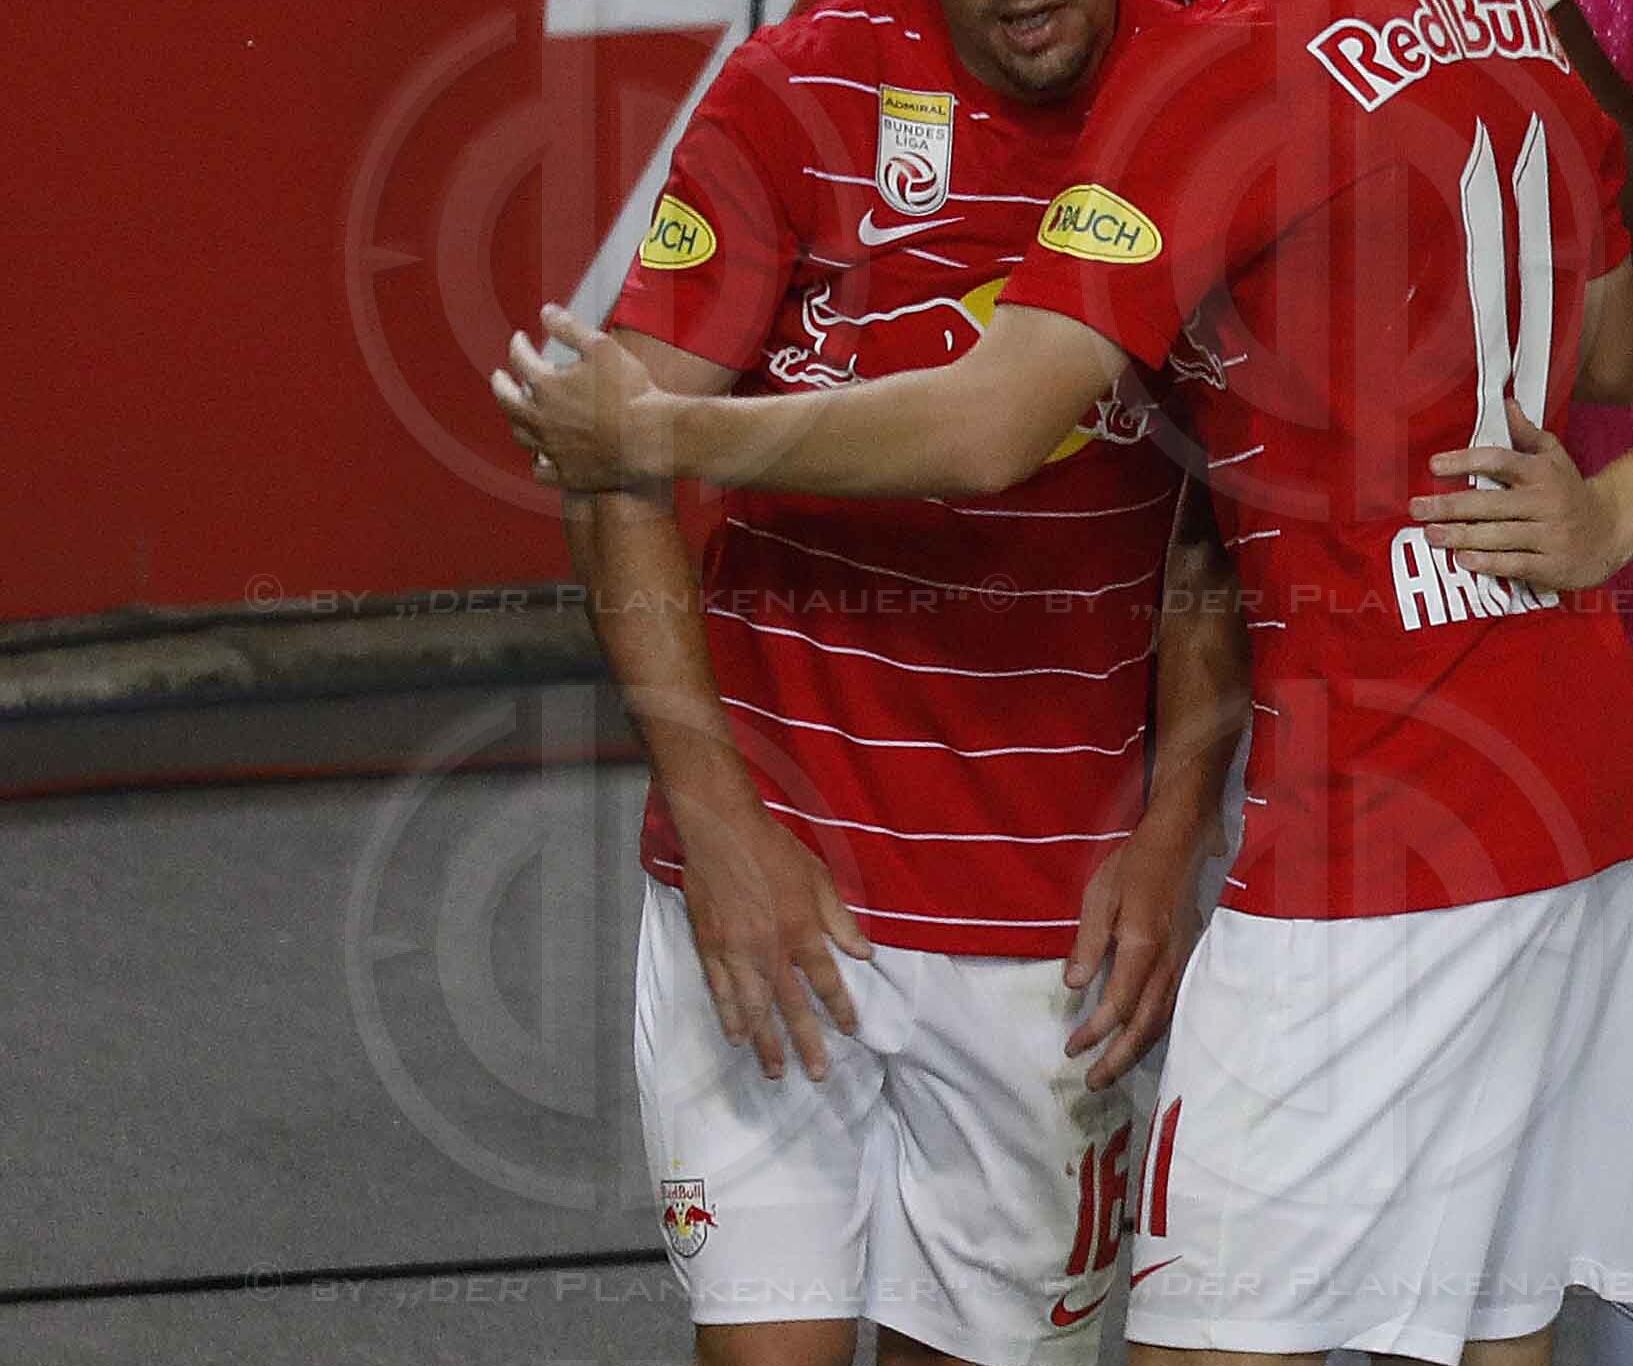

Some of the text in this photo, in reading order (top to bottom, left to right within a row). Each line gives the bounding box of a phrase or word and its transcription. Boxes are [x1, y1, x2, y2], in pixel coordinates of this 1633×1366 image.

[885, 98, 946, 115] ADMIRAL
[884, 119, 945, 140] BUNDES
[895, 135, 929, 151] LIGA
[1459, 111, 1553, 491] 11
